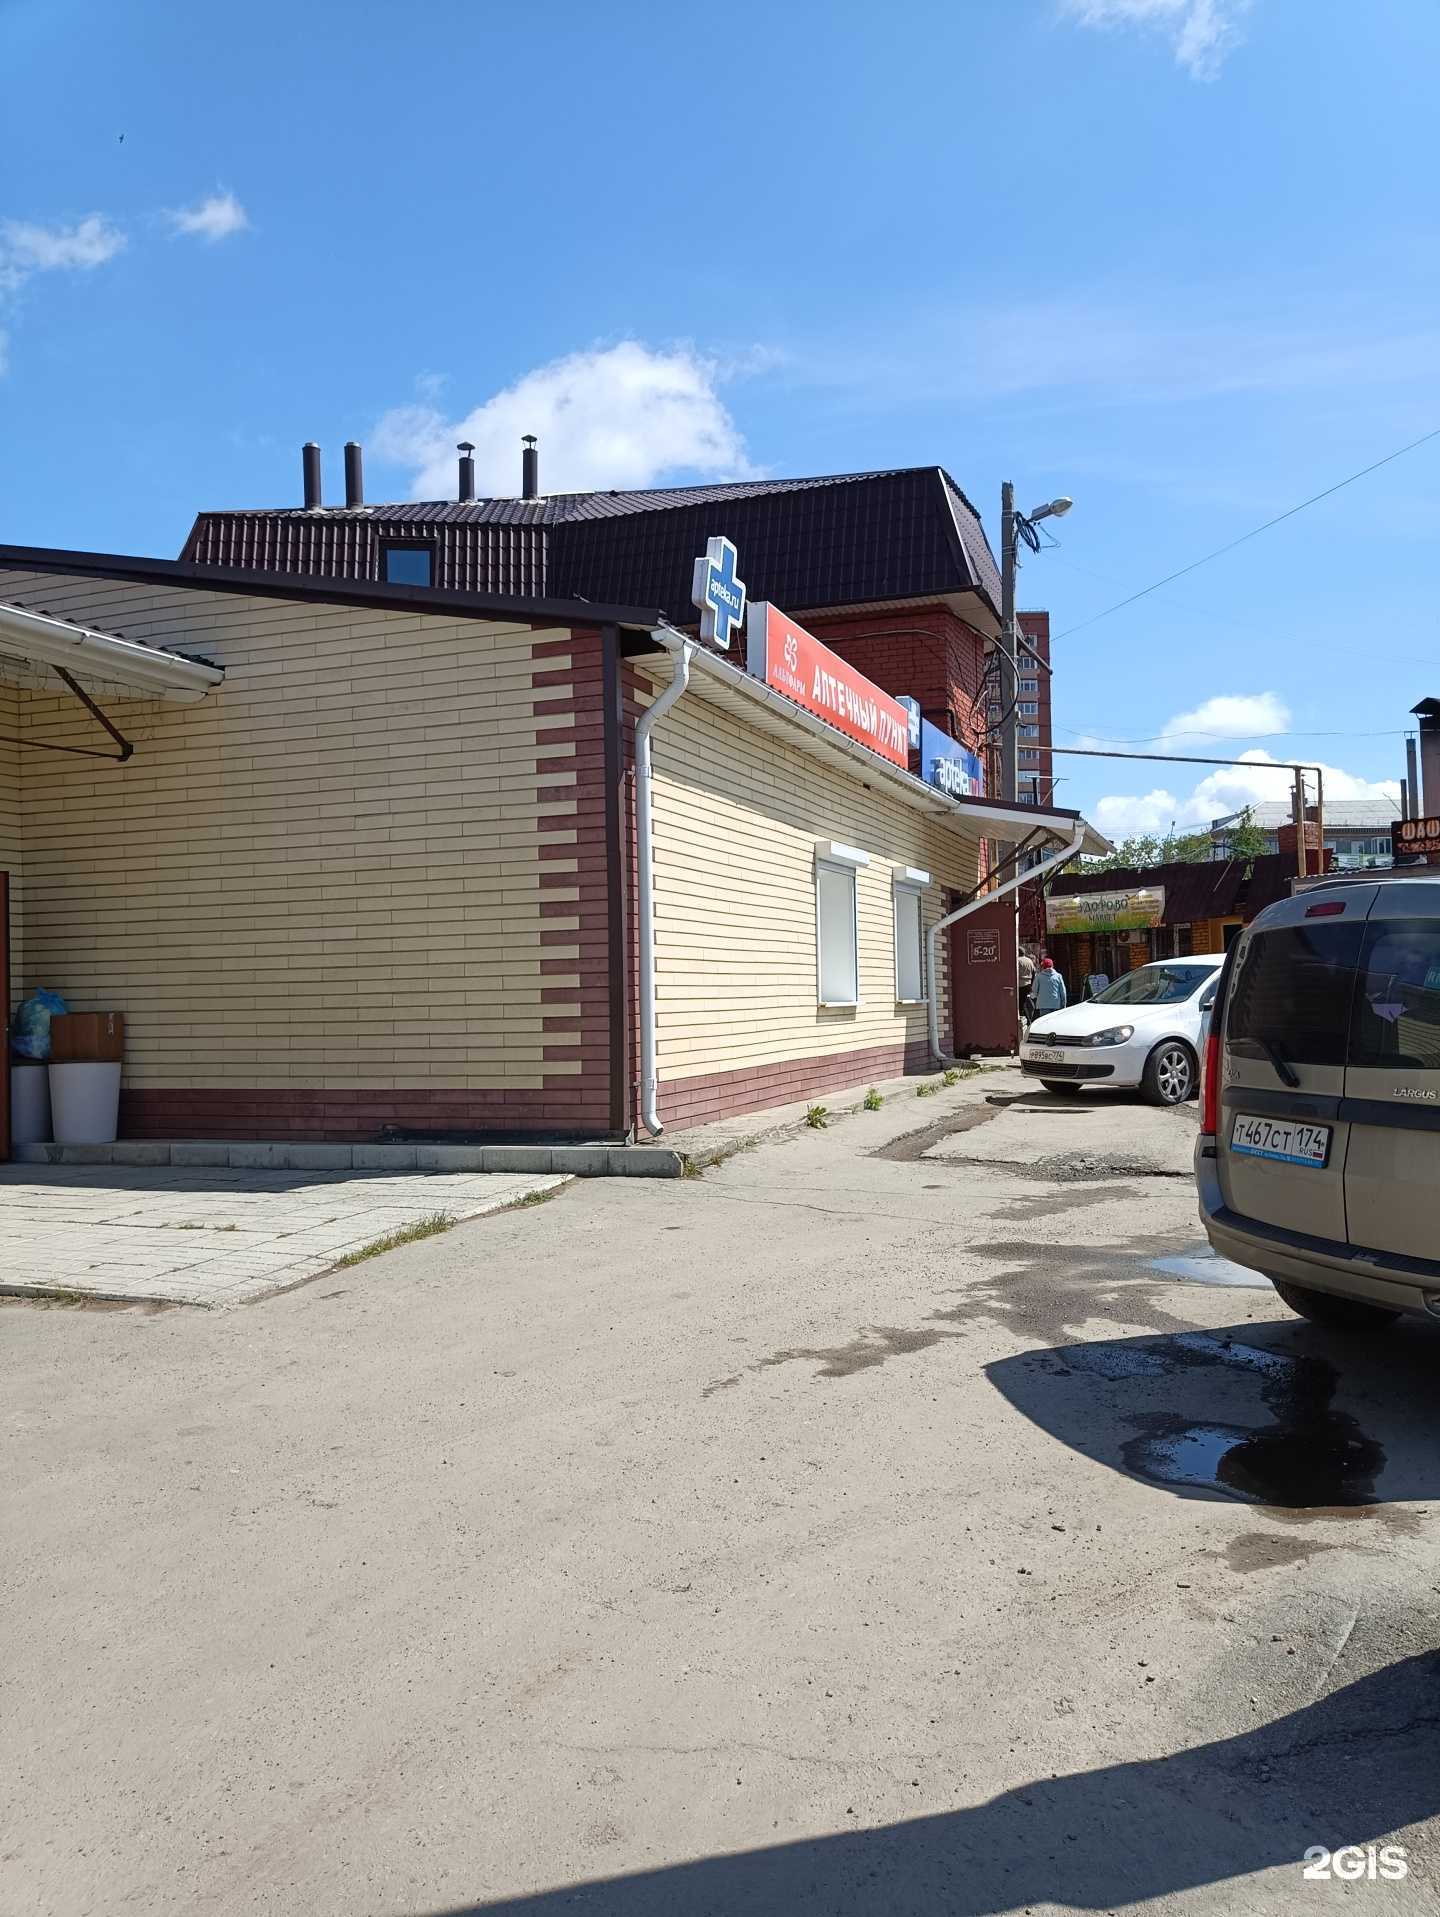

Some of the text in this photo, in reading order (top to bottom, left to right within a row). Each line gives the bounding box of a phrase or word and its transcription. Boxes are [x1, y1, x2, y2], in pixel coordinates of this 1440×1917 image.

[710, 578, 739, 610] apteka.ru
[812, 665, 908, 756] АПТЕЧНЫЙ ПУНКТ
[1392, 1088, 1437, 1099] LARGUS
[1297, 1128, 1322, 1149] 174
